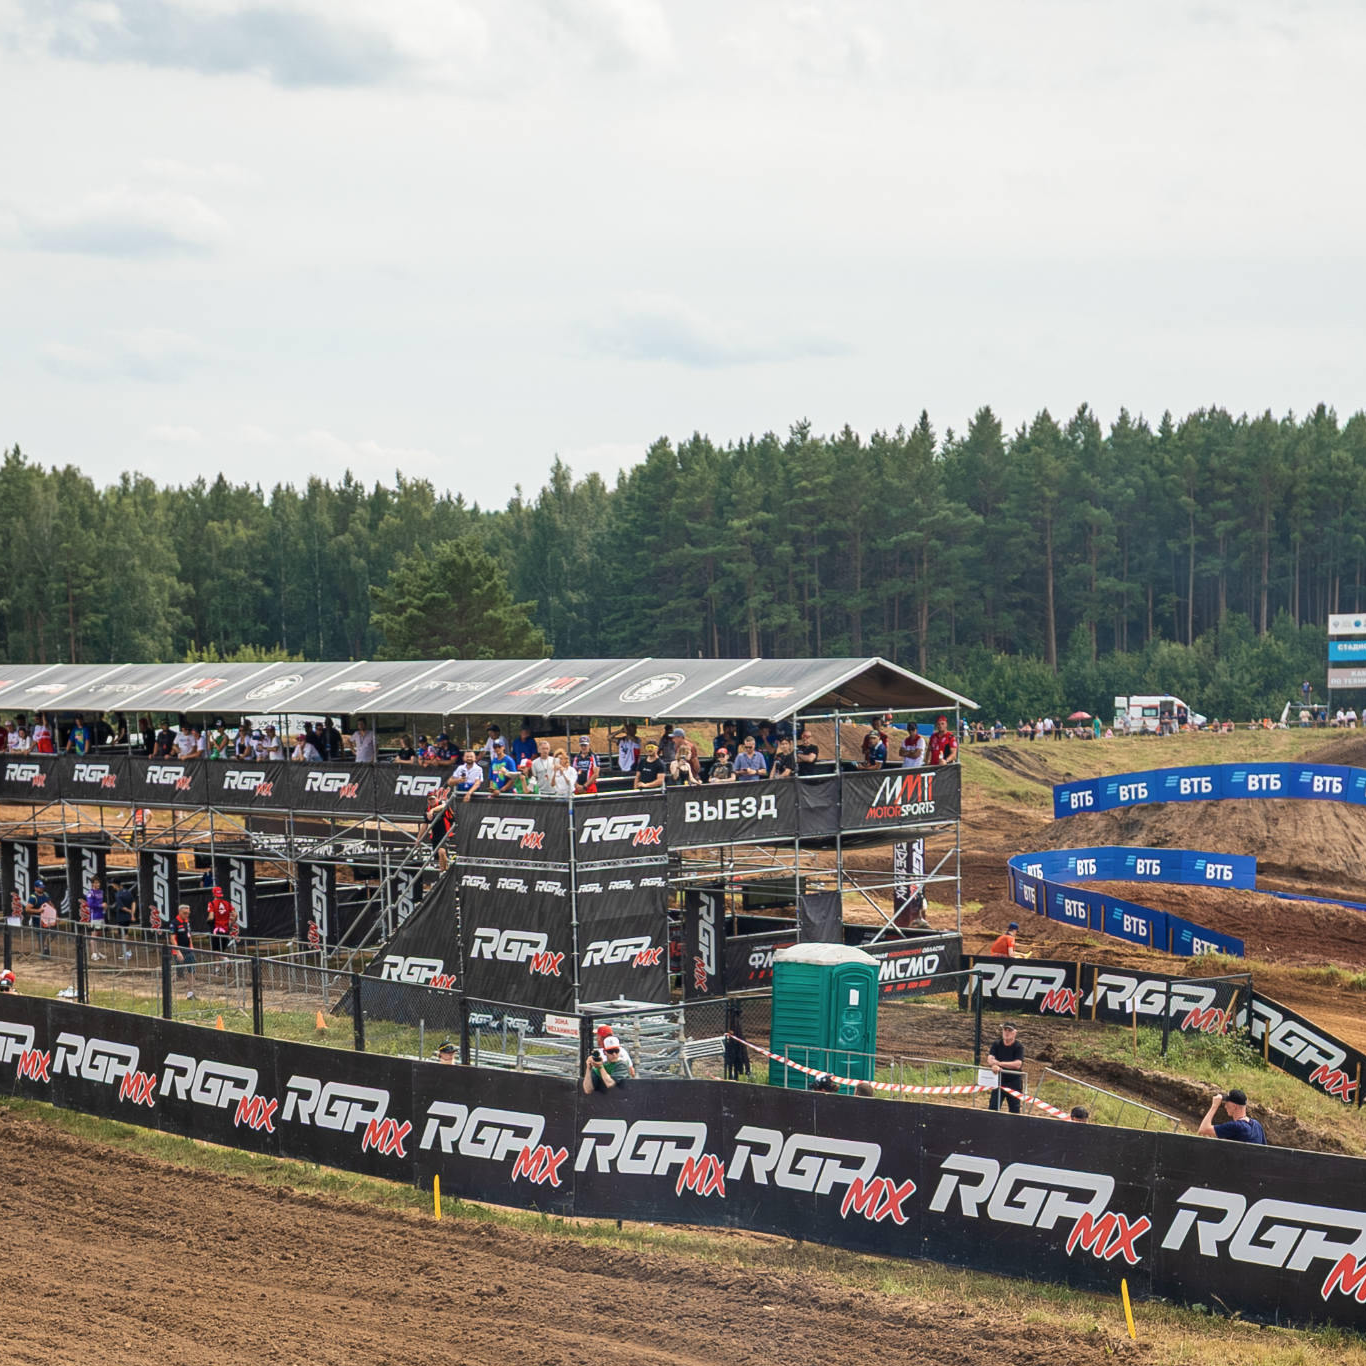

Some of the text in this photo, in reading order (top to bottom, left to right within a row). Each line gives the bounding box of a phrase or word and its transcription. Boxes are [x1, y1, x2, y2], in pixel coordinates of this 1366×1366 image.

[5, 764, 46, 788] RGP MX
[73, 764, 117, 789] RGP MX
[146, 765, 192, 791] RGP MX
[224, 771, 274, 797] RGP MX
[305, 771, 351, 792] RGP
[395, 775, 441, 796] RGP
[1179, 775, 1213, 795] ВТБ
[1247, 772, 1282, 792] ВТБ
[1313, 775, 1343, 794] ВТБ
[1070, 790, 1093, 808] ВТБ
[1119, 782, 1149, 801] ВТБ
[685, 794, 777, 823] ВЫЕЗД
[865, 802, 935, 820] MOTORSPORTS
[477, 817, 545, 849] RGP MX
[579, 814, 664, 846] RGP MX
[1077, 858, 1097, 876] ВТБ
[1136, 858, 1161, 876] ВТБ
[1205, 862, 1233, 881] ВТБ
[470, 927, 566, 977] RGP MX
[581, 936, 664, 968] RGP MX
[693, 891, 716, 992] RGP MX
[964, 963, 1084, 1017] RGP MX
[547, 1026, 578, 1036] МЕХАНИКОВ
[555, 1018, 569, 1026] ЗОНА
[1308, 1064, 1359, 1104] MX
[419, 1100, 570, 1188] RGP MX
[574, 1118, 725, 1199] RGP MX
[727, 1124, 917, 1226] RGP MX
[929, 1153, 1153, 1266] RGP MX
